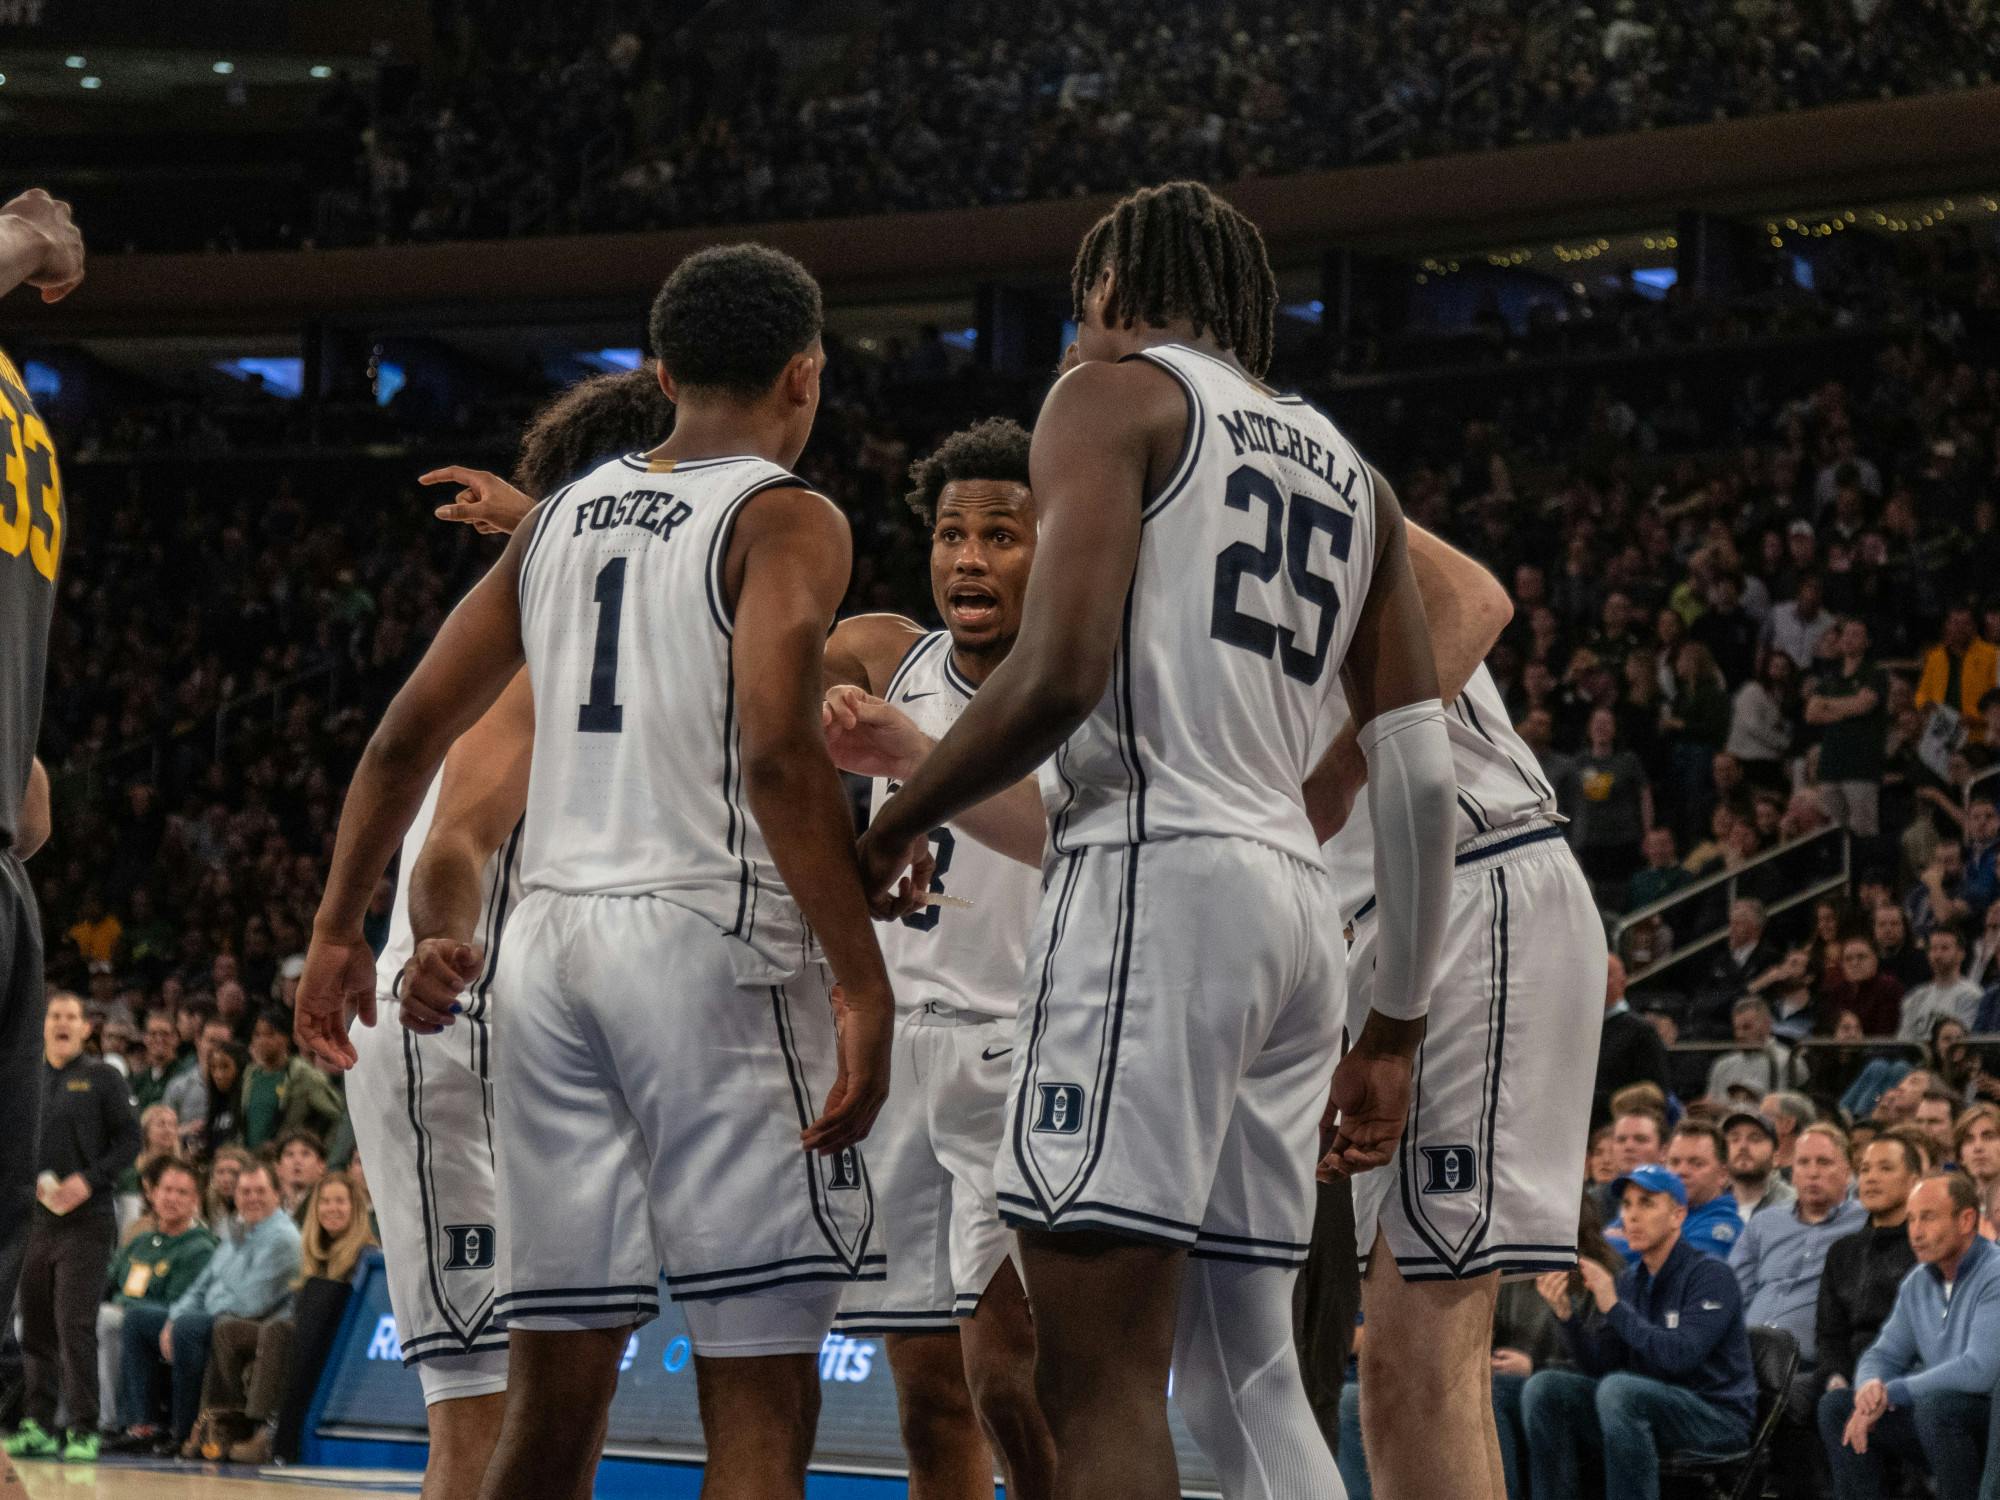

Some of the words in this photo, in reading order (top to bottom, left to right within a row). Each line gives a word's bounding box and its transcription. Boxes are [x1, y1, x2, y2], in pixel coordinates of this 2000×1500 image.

[0, 389, 61, 582] 33
[573, 490, 693, 542] FOSTER
[1217, 410, 1358, 513] MITCHELL
[577, 557, 627, 732] 1
[1210, 464, 1353, 686] 25
